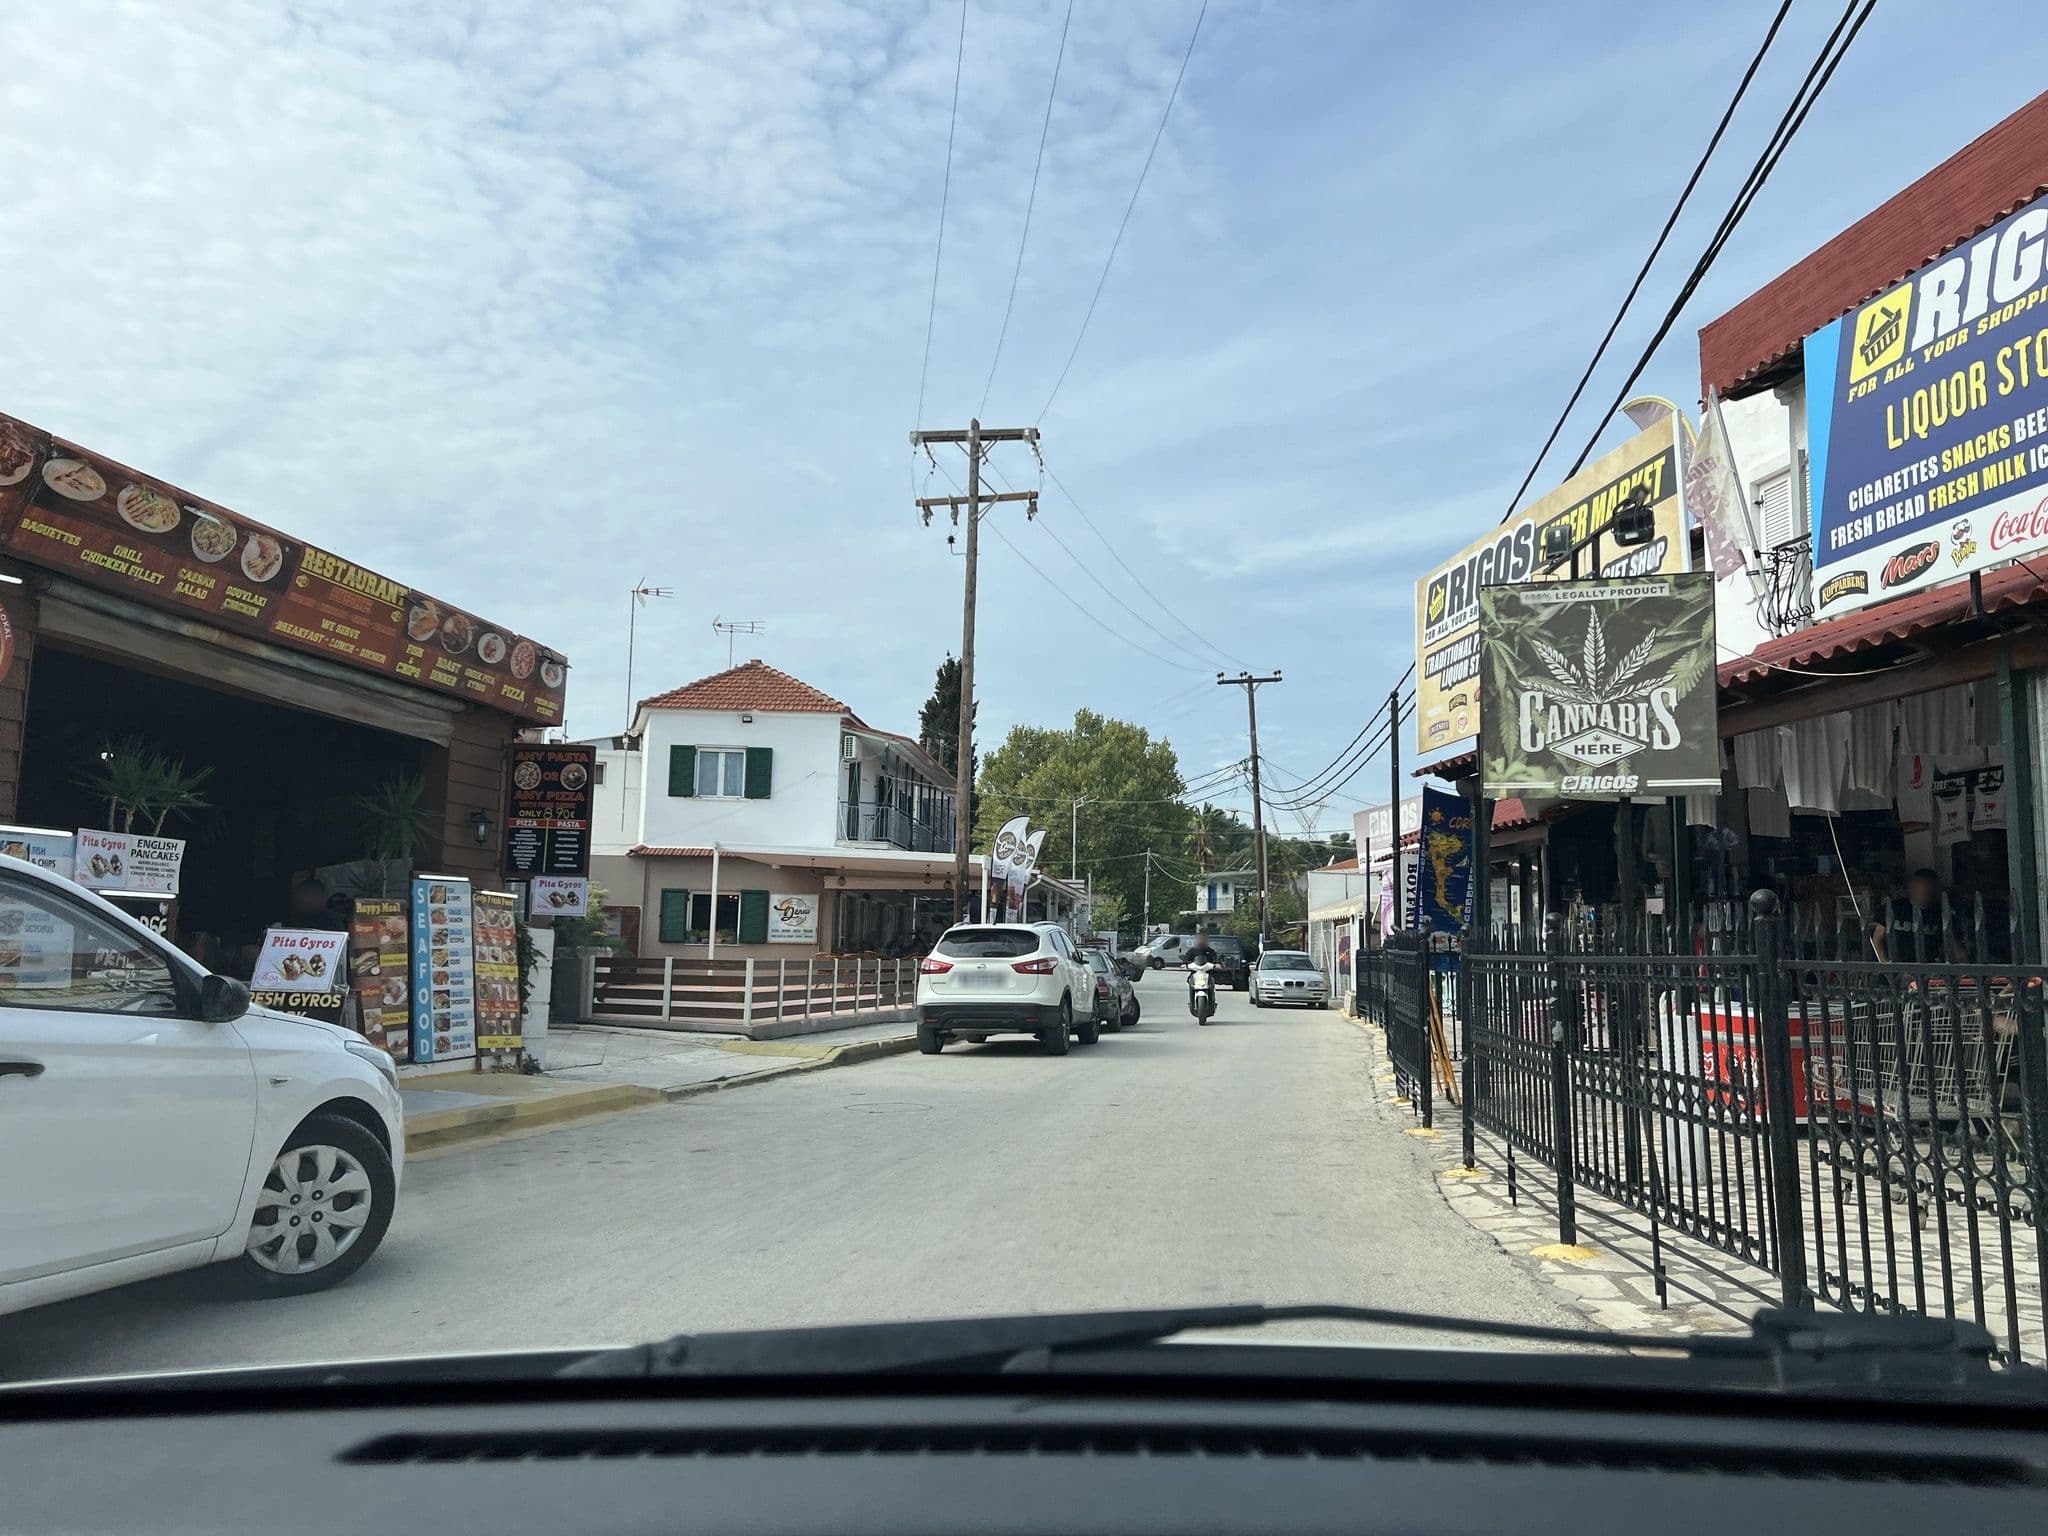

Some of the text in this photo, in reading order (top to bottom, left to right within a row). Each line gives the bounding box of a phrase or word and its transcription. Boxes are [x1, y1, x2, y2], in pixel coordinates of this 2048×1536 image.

[1911, 208, 2048, 352] RIG
[1847, 376, 1878, 403] FOR
[1884, 357, 1914, 384] ALL
[1923, 327, 1969, 363] YOUR
[1886, 360, 1988, 450] LIQUOR
[1848, 455, 1939, 513] CIGARETTES
[1941, 424, 2011, 473] SNACKS
[1830, 514, 1873, 550] FRESH
[1875, 494, 1926, 533] BREAD
[1928, 471, 1980, 513] FRESH
[1982, 452, 2028, 492] MILK
[112, 545, 143, 564] GRILL
[1629, 541, 1666, 577] SHOP
[80, 549, 165, 585] CHICKEN FILLET
[1447, 521, 1534, 619] RIGOS
[1881, 541, 1939, 590] Mars
[302, 547, 409, 606] RESTAURANT
[176, 581, 208, 600] SALAD
[1555, 590, 1606, 600] LEGALLY
[1610, 585, 1666, 596] PRODUCT
[275, 620, 325, 644] BREAKFAST
[1426, 641, 1473, 676] TRADITIONAL
[1441, 662, 1468, 689] LIQUOR
[501, 685, 526, 702] PIZZA
[1519, 687, 1681, 753] CANNABIS
[547, 752, 590, 763] PASTA
[1573, 743, 1623, 755] HERE
[1578, 775, 1639, 790] RIGOS
[546, 791, 585, 801] PIZZA
[519, 809, 542, 818] ONLY
[82, 835, 126, 851] Pita Gyros
[137, 839, 178, 851] ENGLISH
[130, 849, 180, 861] PANCAKES
[539, 879, 582, 890] Pita Gyros
[272, 936, 336, 951] Pita Gyros
[289, 993, 342, 1008] GYROS
